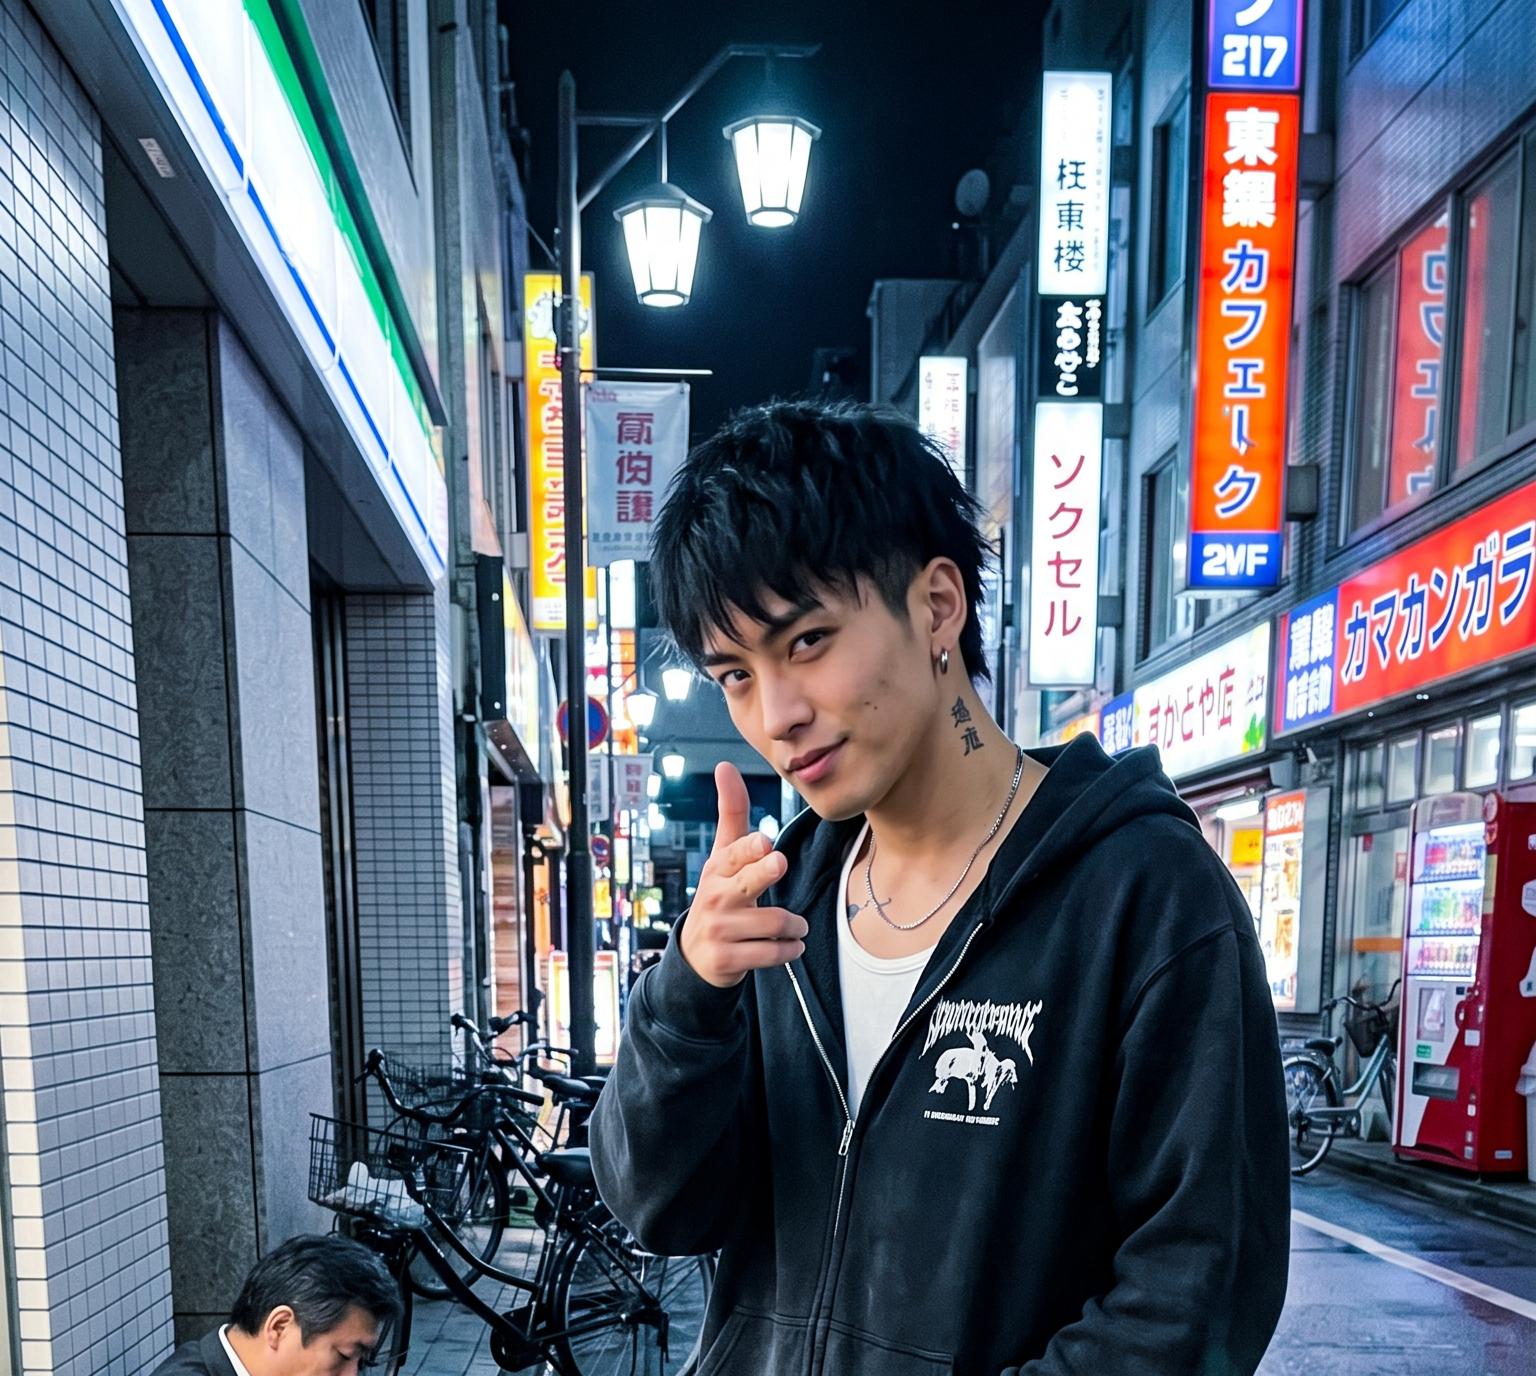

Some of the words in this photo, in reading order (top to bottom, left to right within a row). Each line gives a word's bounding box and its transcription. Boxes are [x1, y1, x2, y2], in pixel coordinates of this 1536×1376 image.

[1222, 34, 1288, 77] 217
[1044, 454, 1085, 637] ソクセル
[1340, 520, 1536, 686] カマカンガラ
